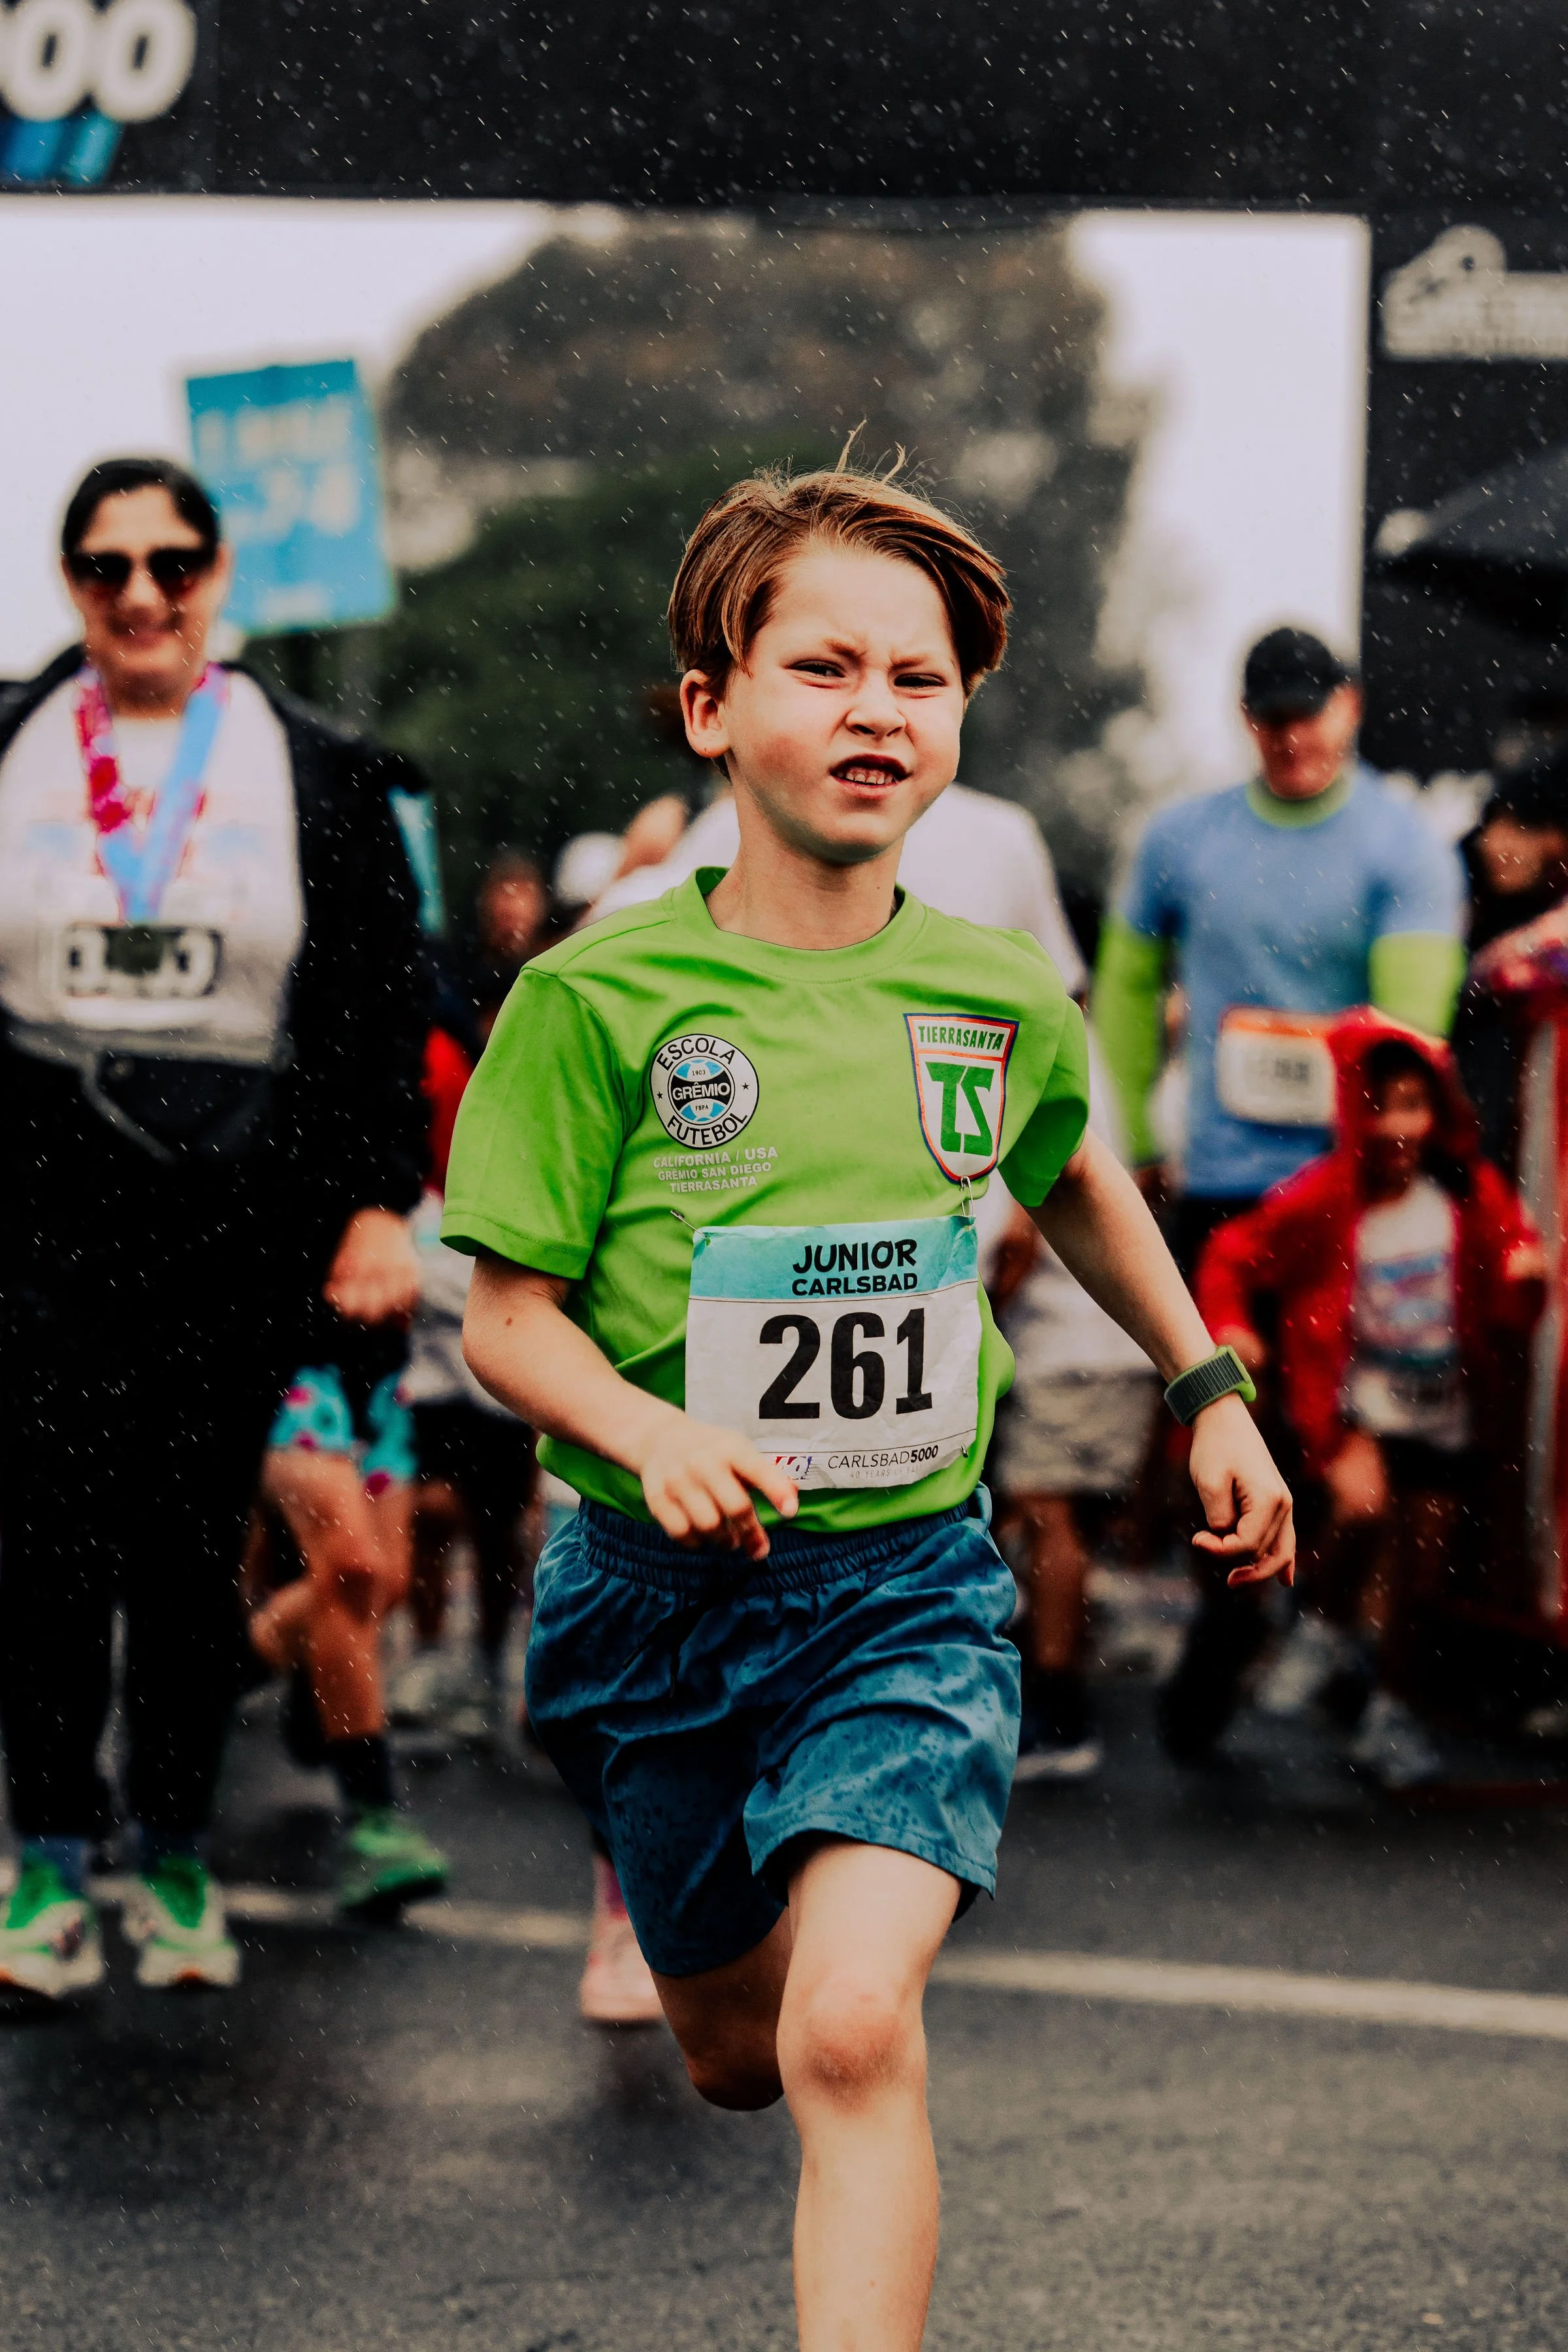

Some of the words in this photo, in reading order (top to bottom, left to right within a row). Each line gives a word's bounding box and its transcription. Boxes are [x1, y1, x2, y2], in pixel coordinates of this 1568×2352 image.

[918, 1026, 1005, 1051] TIERRASANTA
[657, 1037, 736, 1071] ESCOLA
[672, 1081, 730, 1101] GRÊMIO
[925, 1061, 994, 1156] TS
[667, 1113, 748, 1145] FUTEBOL
[653, 1151, 731, 1168] CALIFORNIA
[736, 1150, 740, 1162] /
[745, 1147, 778, 1160] USA
[702, 1166, 726, 1179] SAN
[730, 1162, 772, 1175] DIEGO
[670, 1176, 757, 1193] TIERRASANTA
[792, 1239, 917, 1274] JUNIOR
[792, 1273, 918, 1296] CARLSBAD
[759, 1307, 933, 1420] 261
[828, 1445, 939, 1469] CARLSBAD5000
[864, 1469, 890, 1478] YEARS
